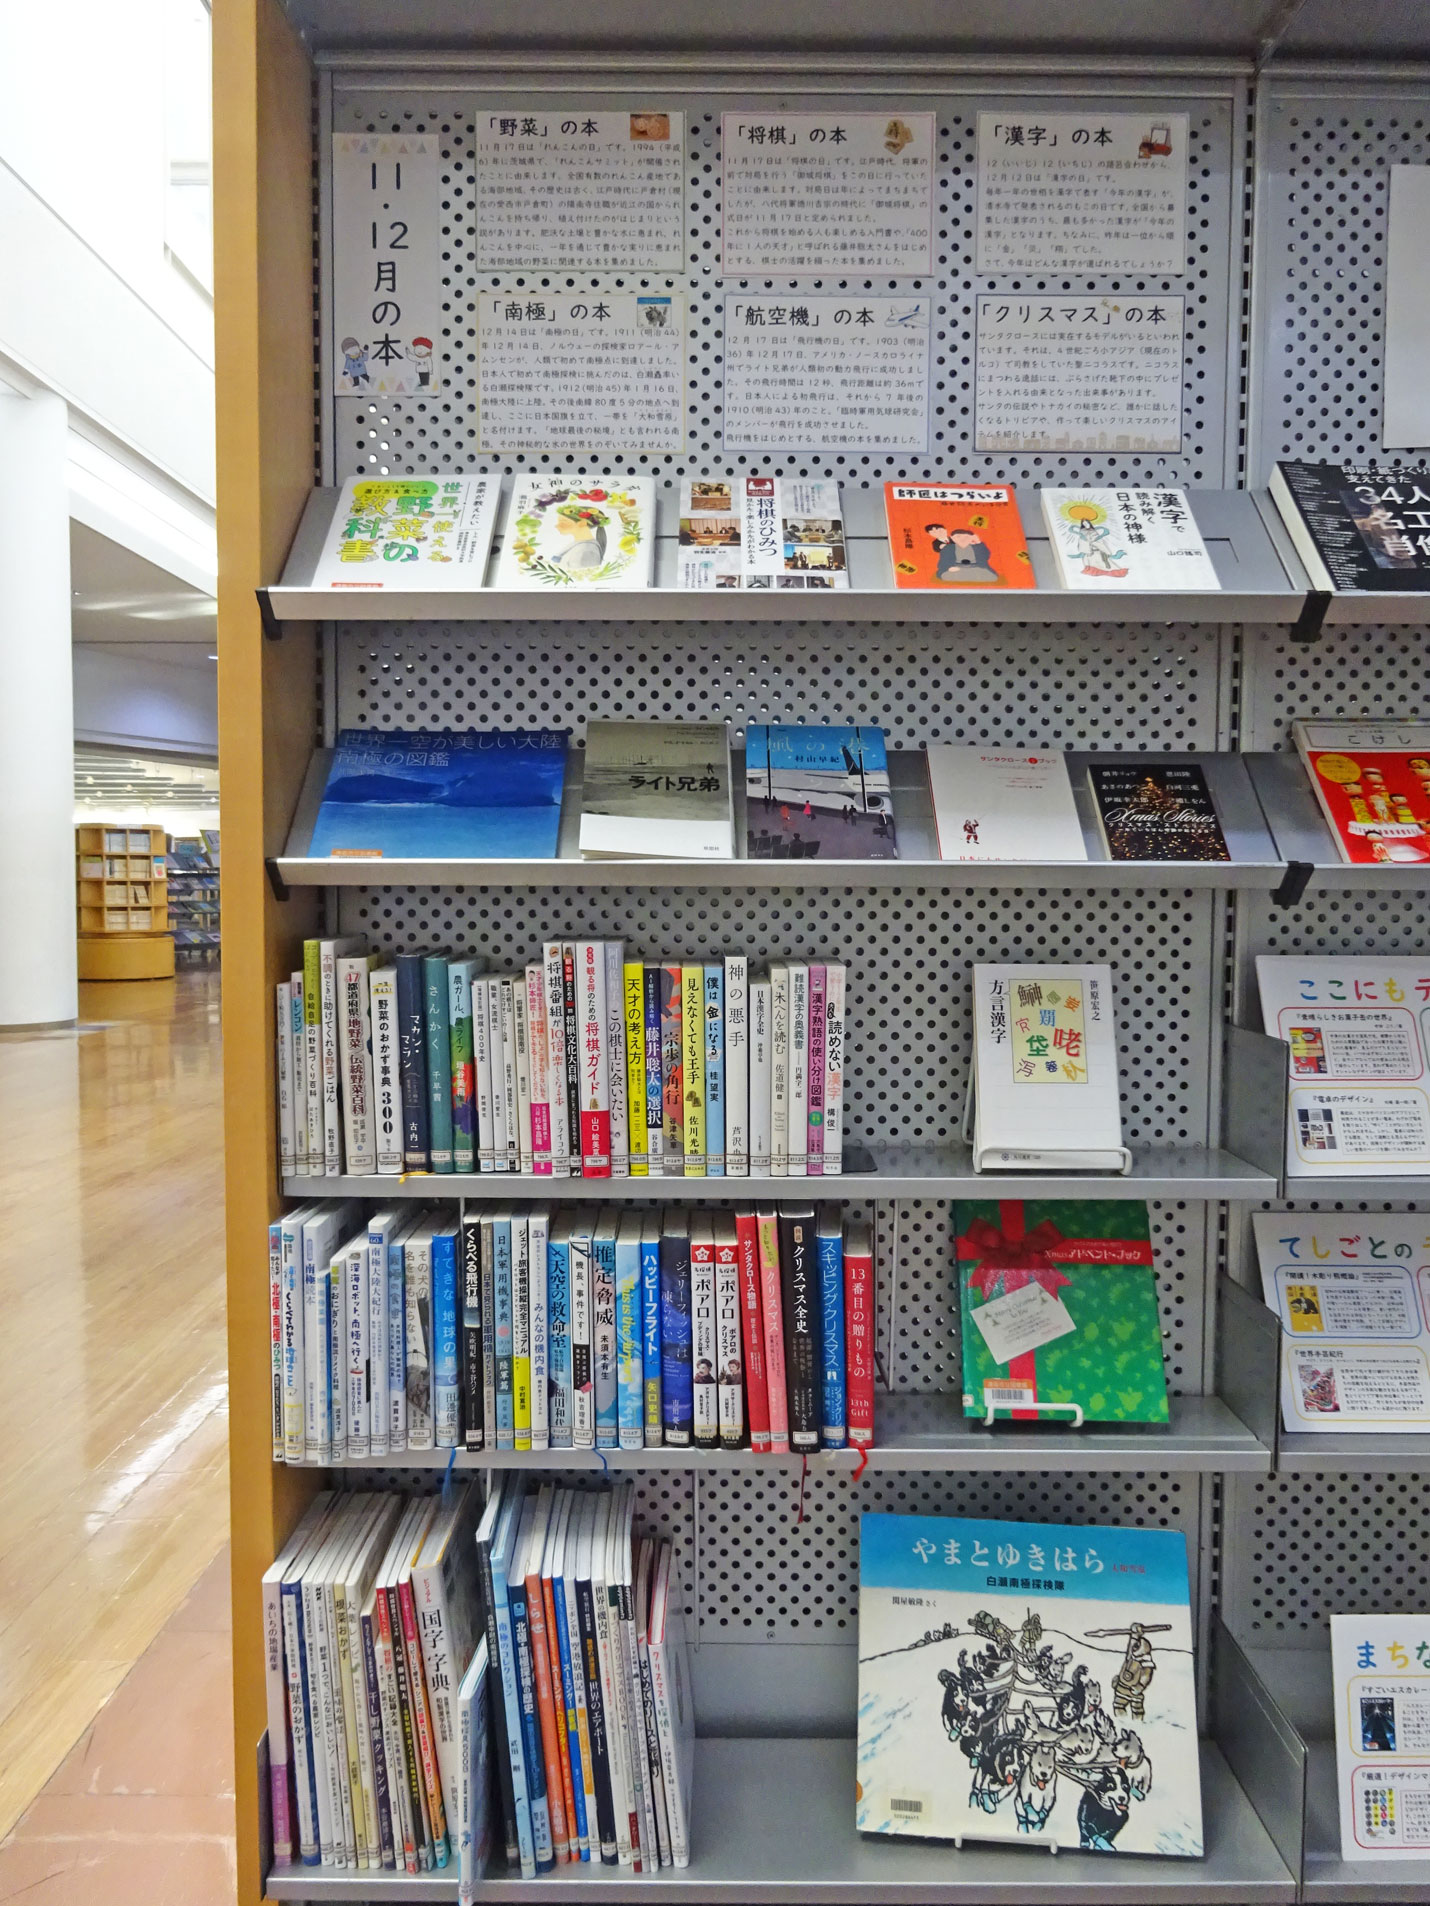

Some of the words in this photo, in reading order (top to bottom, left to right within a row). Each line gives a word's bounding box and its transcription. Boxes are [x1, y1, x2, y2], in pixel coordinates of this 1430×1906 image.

[489, 117, 600, 138] 「野菜」の本
[738, 124, 848, 145] 「将棋」の本
[993, 124, 1113, 147] 「漢字」の本
[493, 300, 611, 322] 「南極」の本
[734, 304, 875, 327] 「航空機」の本
[982, 303, 1166, 325] 「クリスマス」の本
[898, 488, 1004, 500] 師匠はつらいよ
[1135, 492, 1156, 524] 読み解く
[1153, 493, 1188, 533] 漢字で
[757, 497, 777, 557] 将棋のひみつ
[1116, 492, 1148, 545] 日本の神様
[337, 751, 450, 767] 南極の図鑑
[344, 733, 562, 750] 世界一空が美しい大陸
[628, 775, 720, 792] ライト兄弟
[1105, 808, 1161, 823] Xmas
[1163, 808, 1216, 823] Stories
[706, 977, 720, 1056] 僕は金になる
[728, 964, 745, 1047] 神の悪手
[988, 979, 1007, 1044] 方言漢字
[1089, 980, 1101, 1021] 笹原宏之
[627, 978, 642, 1065] 天才の考え方
[686, 978, 700, 1085] 見えなくても王手
[609, 1009, 624, 1121] この棋士に会いたい
[646, 1027, 661, 1124] 藤井聡太の選択
[827, 1020, 842, 1100] 読めない漢字
[710, 1071, 719, 1102] 桂望実
[1279, 1235, 1430, 1259] てしごとの
[466, 1228, 478, 1308] くらべる飛行機
[595, 1245, 613, 1326] 推定脅威
[744, 1240, 757, 1310] サンタクロース物語
[643, 1255, 658, 1356] ハッピーフライト
[695, 1278, 711, 1318] ポアロ
[720, 1279, 736, 1319] ポアロ
[767, 1271, 779, 1333] クリスマス
[793, 1245, 808, 1334] クリスマス全史
[822, 1241, 840, 1367] スキッピング・クリスマス
[851, 1268, 866, 1377] 13番目の贈りもの
[914, 1537, 1105, 1575] やまとゆきはら
[986, 1575, 1065, 1591] 白瀬南極探検隊
[528, 1593, 544, 1634] しらせ
[421, 1608, 451, 1692] 国字字典
